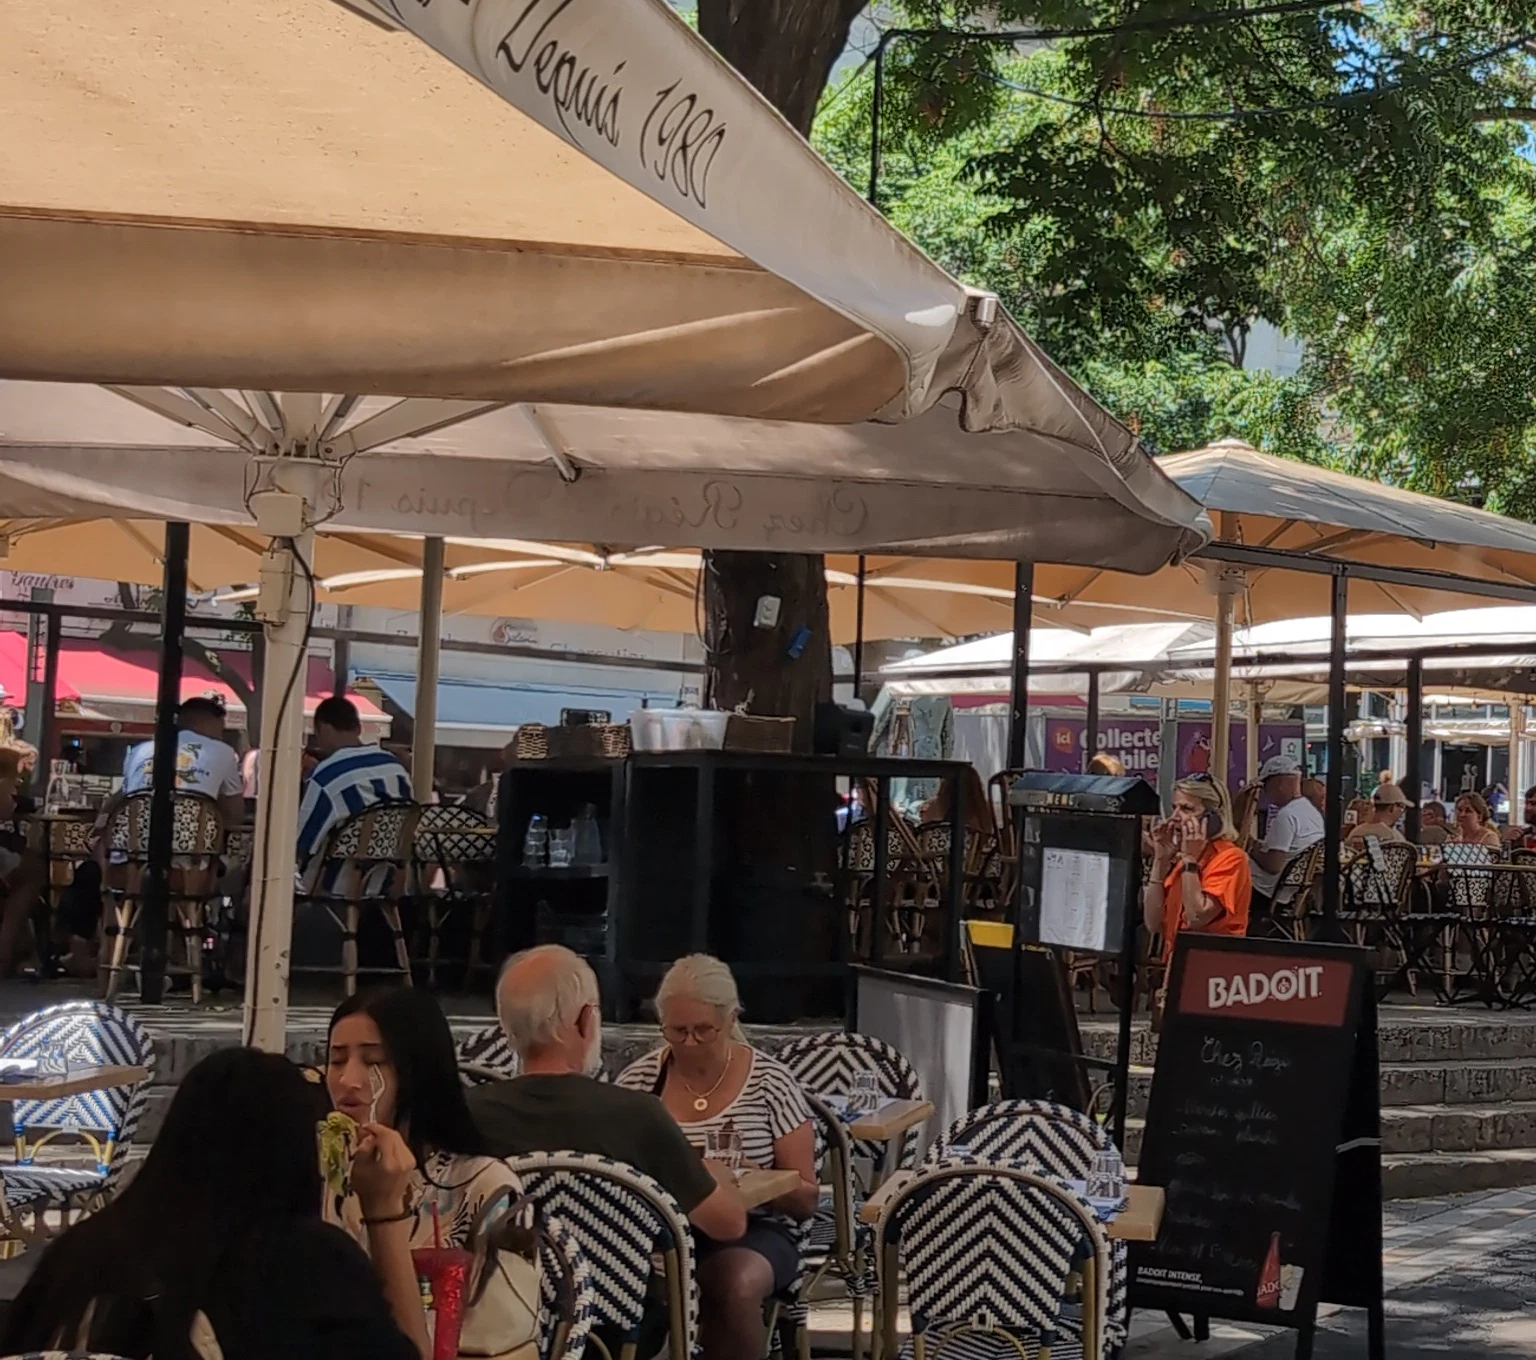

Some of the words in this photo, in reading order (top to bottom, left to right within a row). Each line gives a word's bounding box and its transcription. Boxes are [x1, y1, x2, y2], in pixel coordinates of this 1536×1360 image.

[640, 78, 726, 210] 1980
[1081, 748, 1160, 772] bile
[1208, 966, 1323, 1009] BADOIT
